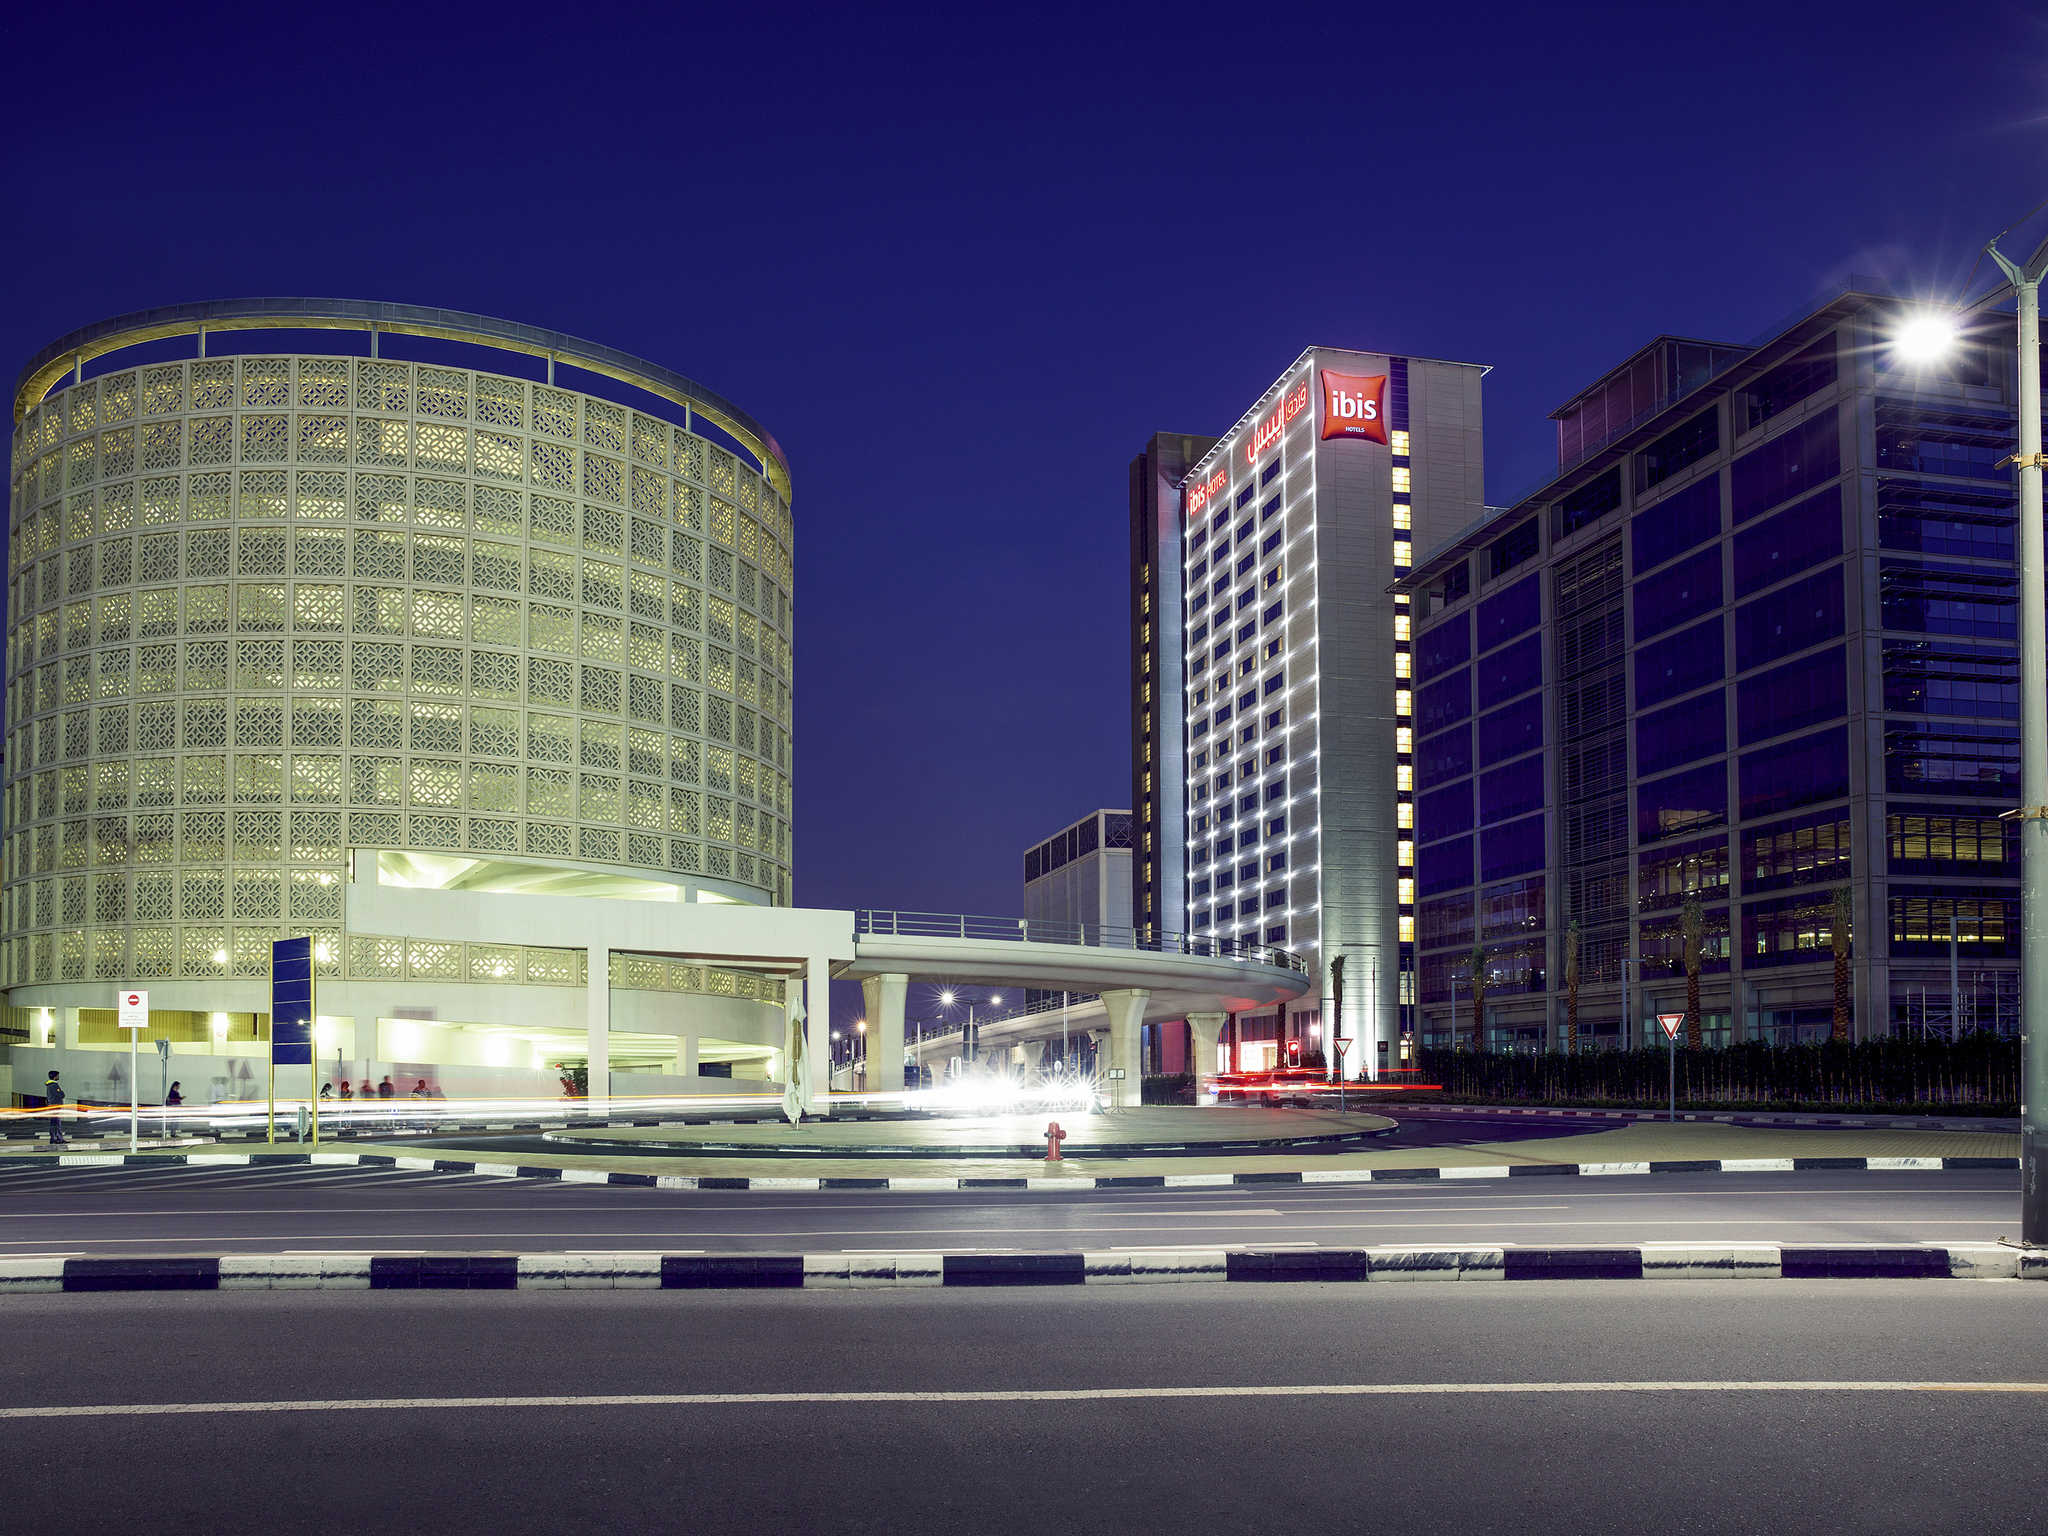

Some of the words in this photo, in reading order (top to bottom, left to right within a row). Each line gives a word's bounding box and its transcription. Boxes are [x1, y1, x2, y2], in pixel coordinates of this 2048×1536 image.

[1285, 381, 1307, 421] فندق
[1332, 390, 1377, 420] ibis
[1189, 484, 1205, 516] ibis
[1206, 470, 1226, 497] HOTEL
